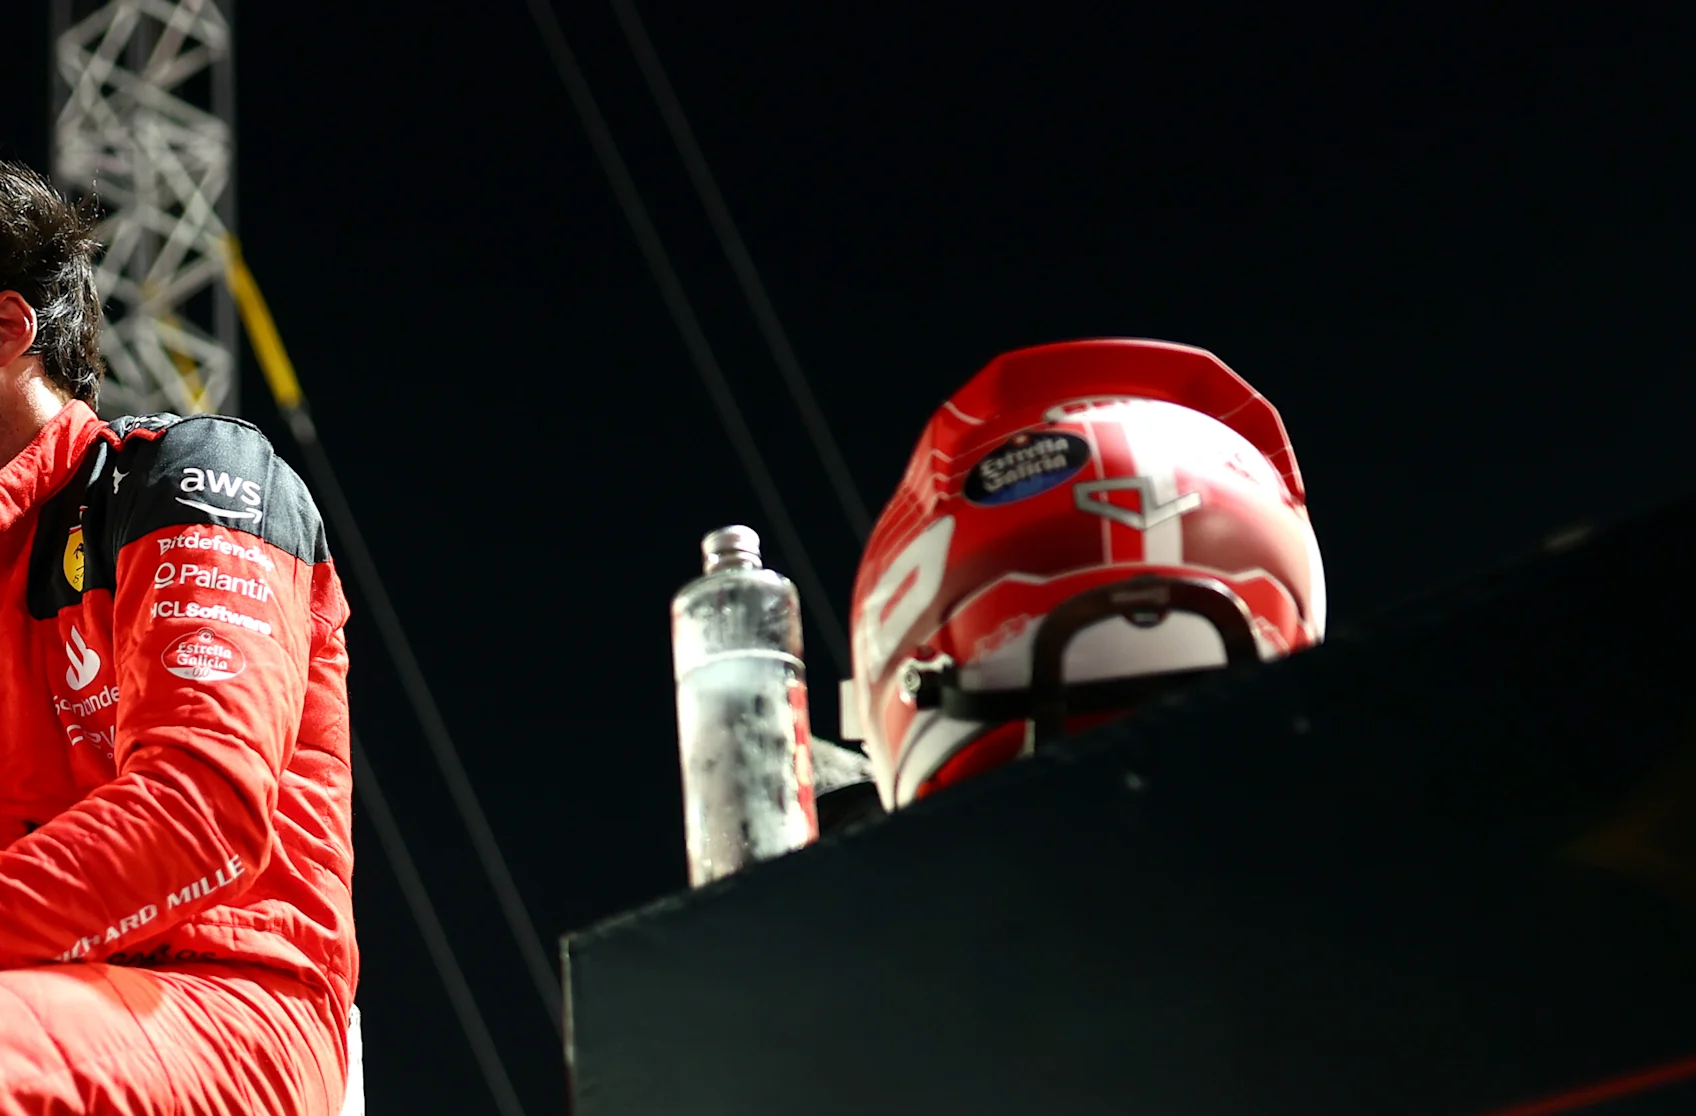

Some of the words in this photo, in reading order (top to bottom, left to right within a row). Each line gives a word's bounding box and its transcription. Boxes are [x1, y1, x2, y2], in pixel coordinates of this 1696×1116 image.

[180, 467, 261, 506] aws
[179, 563, 272, 603] Palantir
[176, 642, 232, 659] Estrella
[177, 653, 228, 670] Galicia
[167, 854, 245, 910] MILLE
